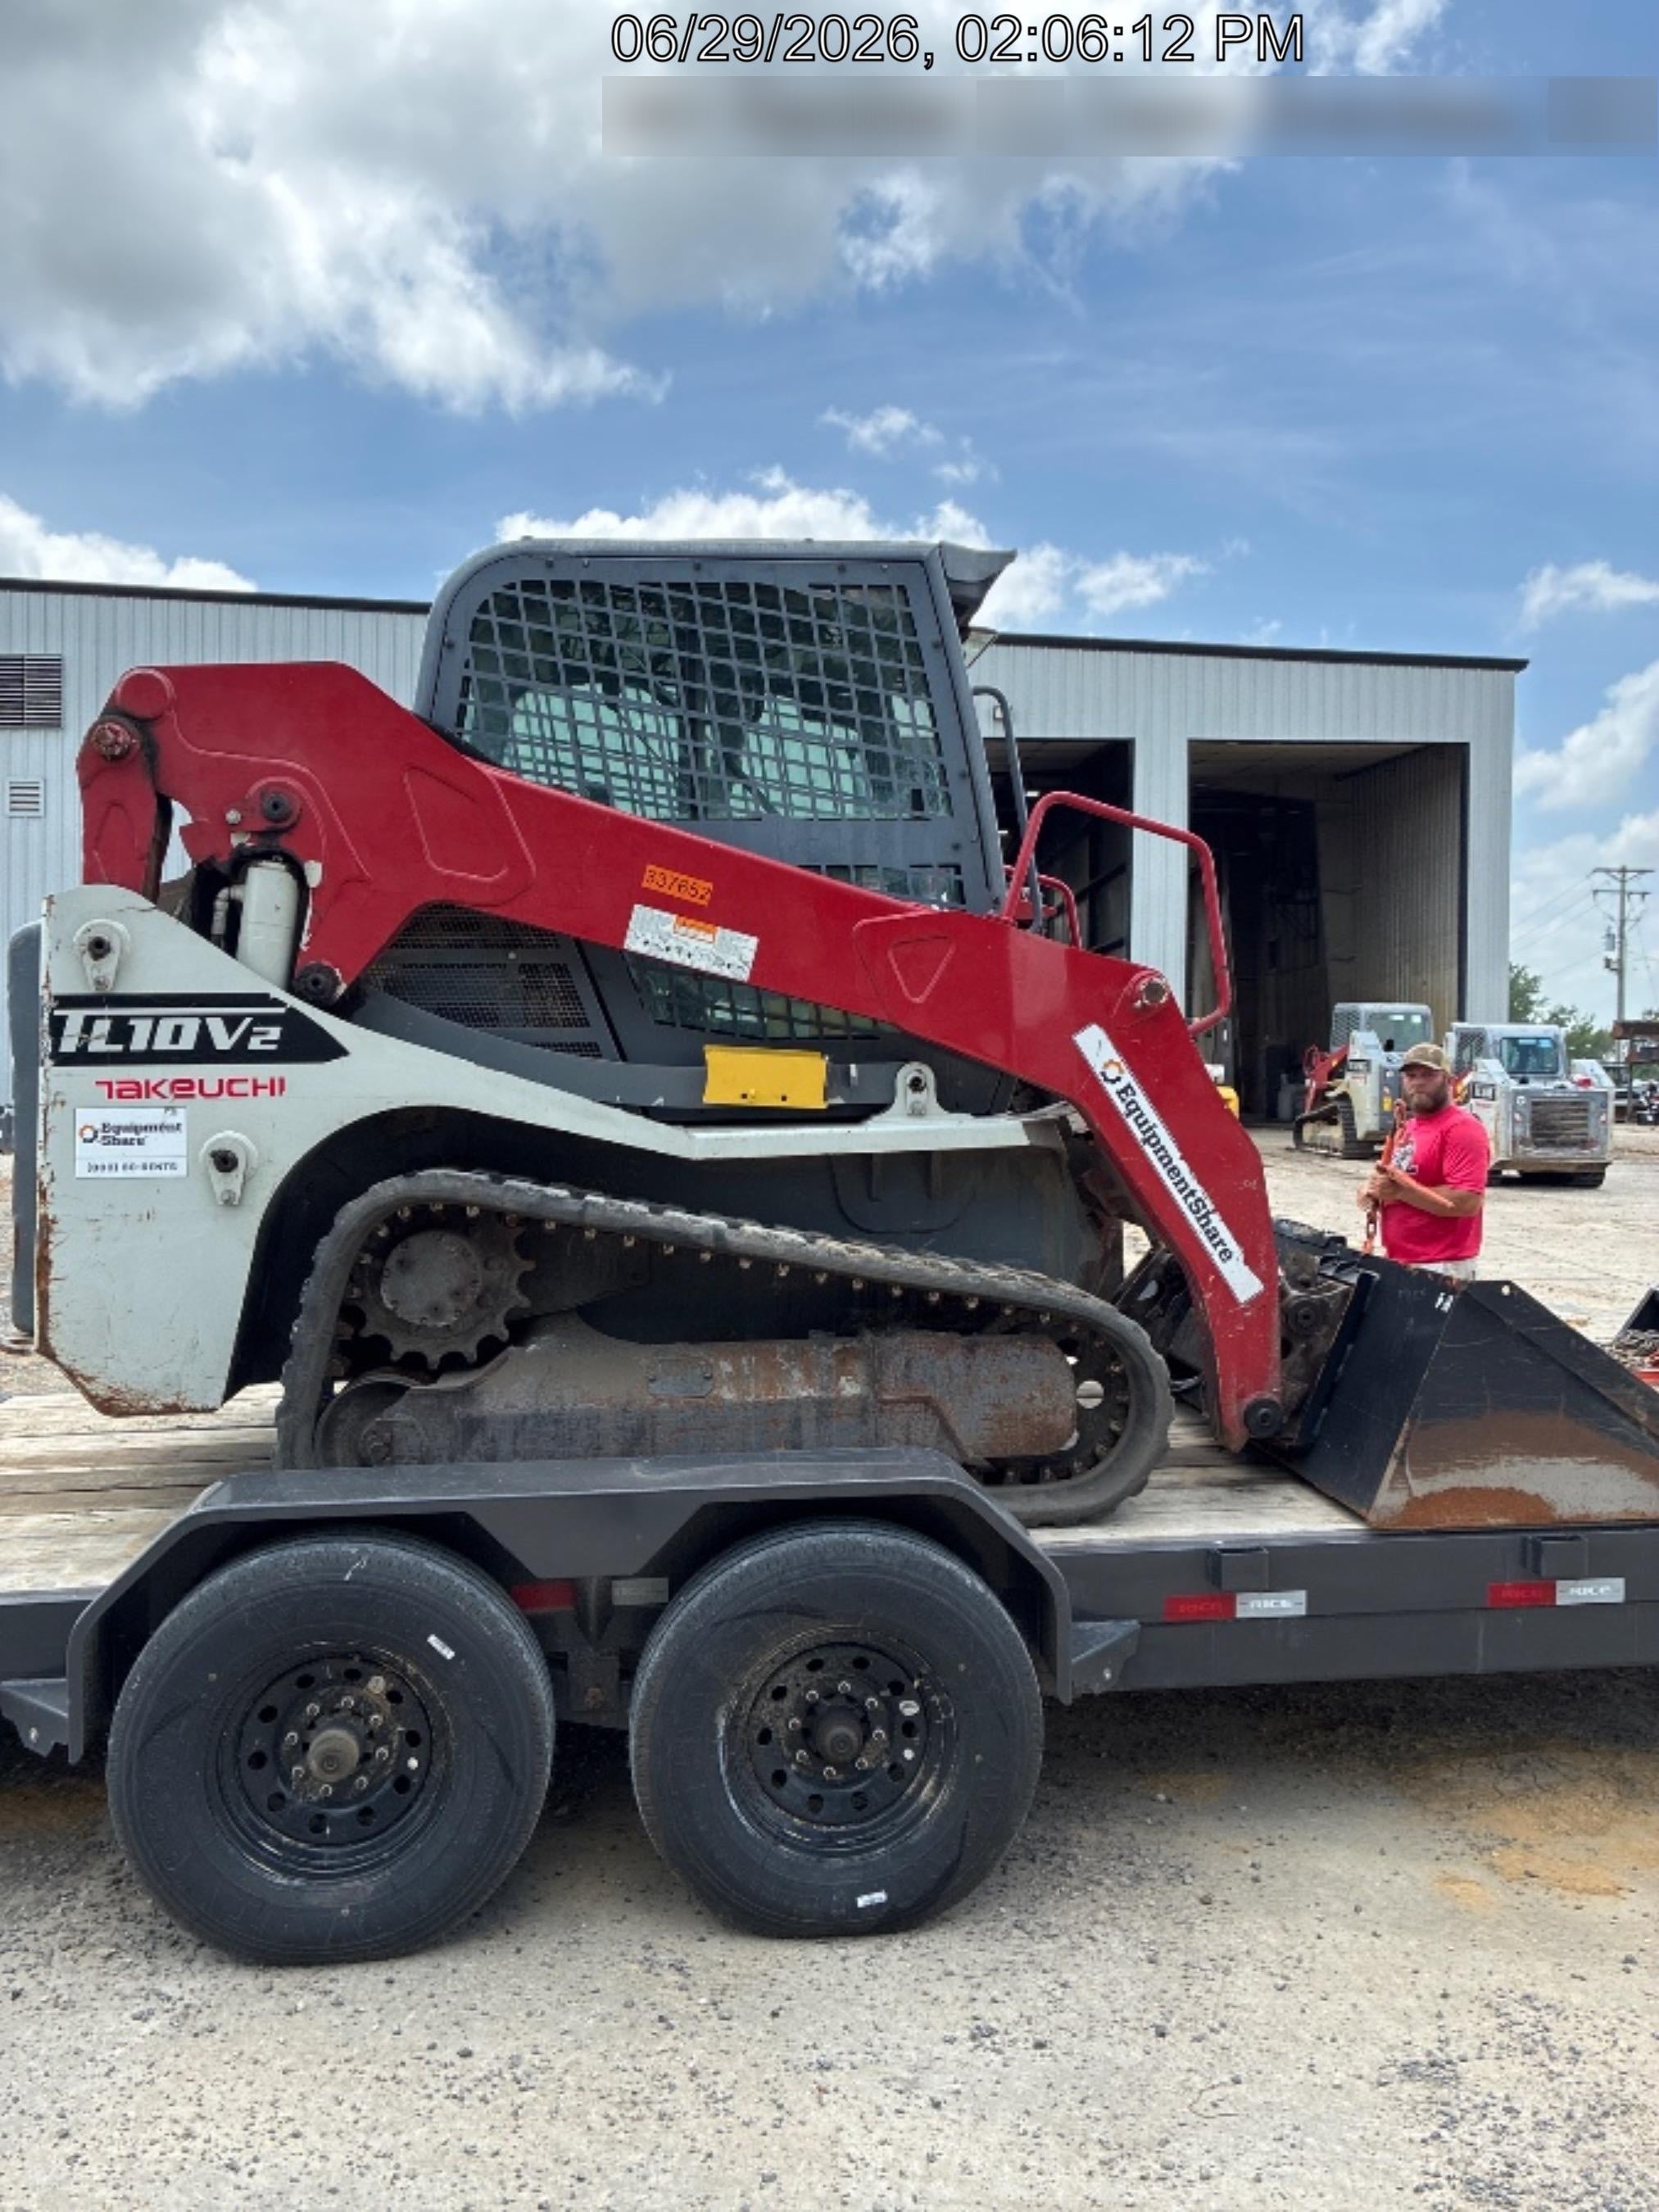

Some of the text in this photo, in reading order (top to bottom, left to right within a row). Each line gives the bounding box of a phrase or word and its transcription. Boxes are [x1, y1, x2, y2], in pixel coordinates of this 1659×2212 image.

[101, 1122, 182, 1135] Equipment
[101, 1135, 146, 1146] Share
[1116, 1083, 1233, 1263] EquipmentShare
